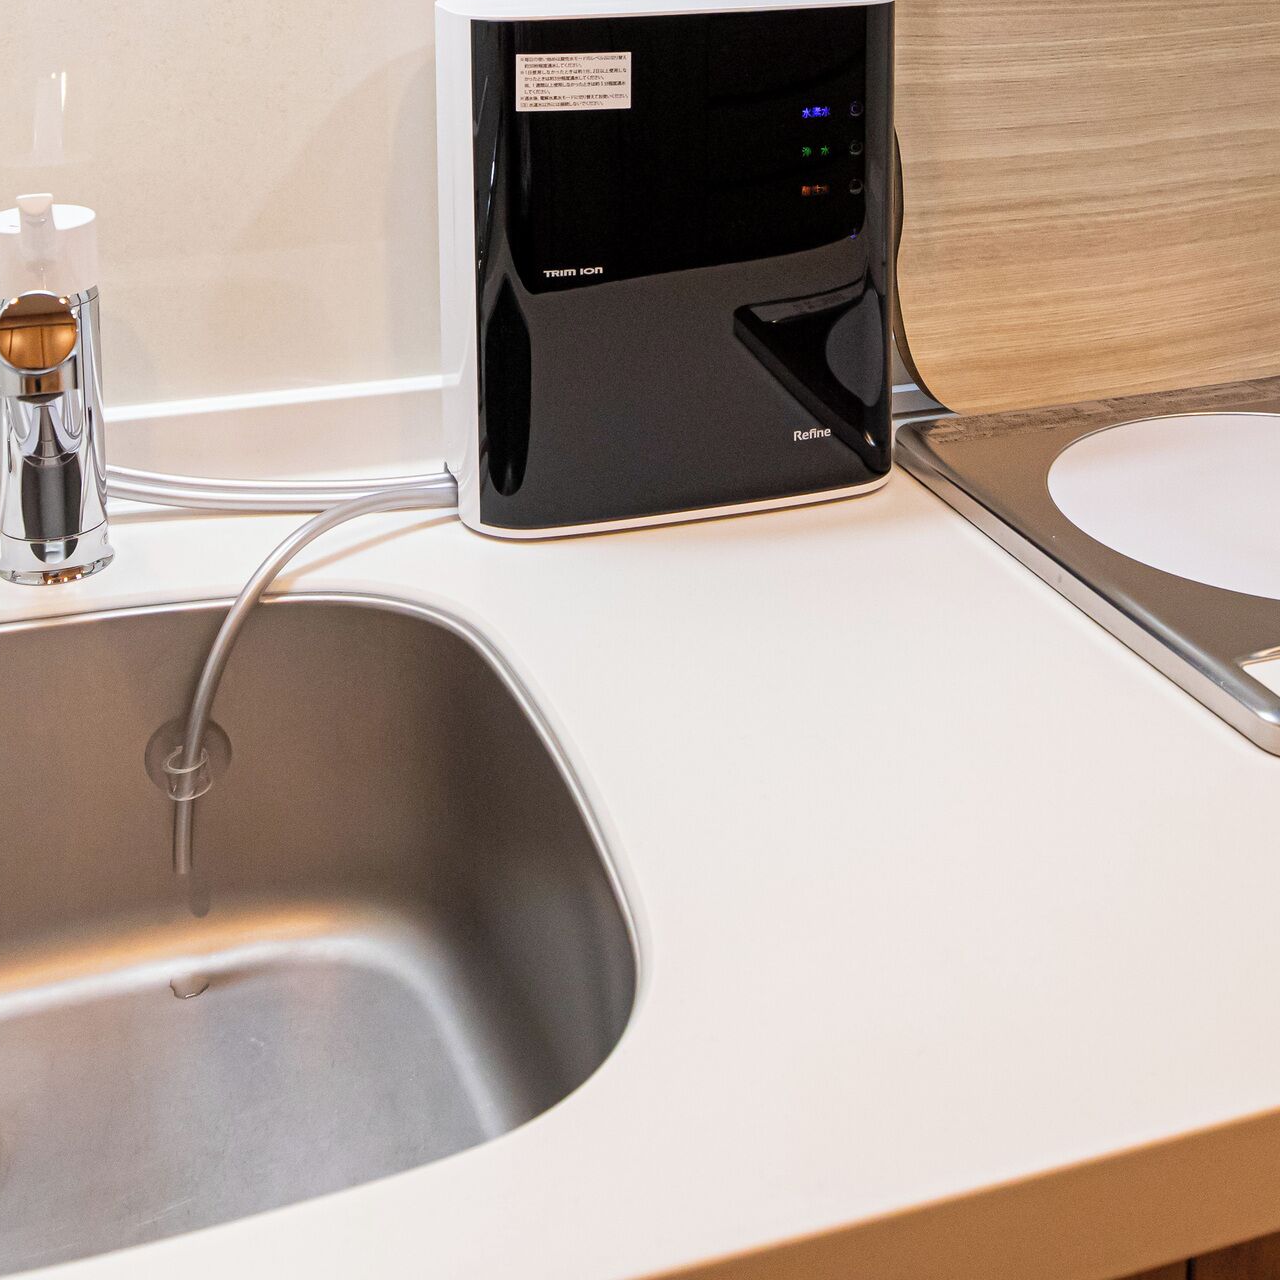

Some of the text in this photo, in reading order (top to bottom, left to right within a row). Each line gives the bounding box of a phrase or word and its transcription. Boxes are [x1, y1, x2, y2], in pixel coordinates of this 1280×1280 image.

[801, 105, 831, 119] 水素水
[793, 426, 832, 443] Refine
